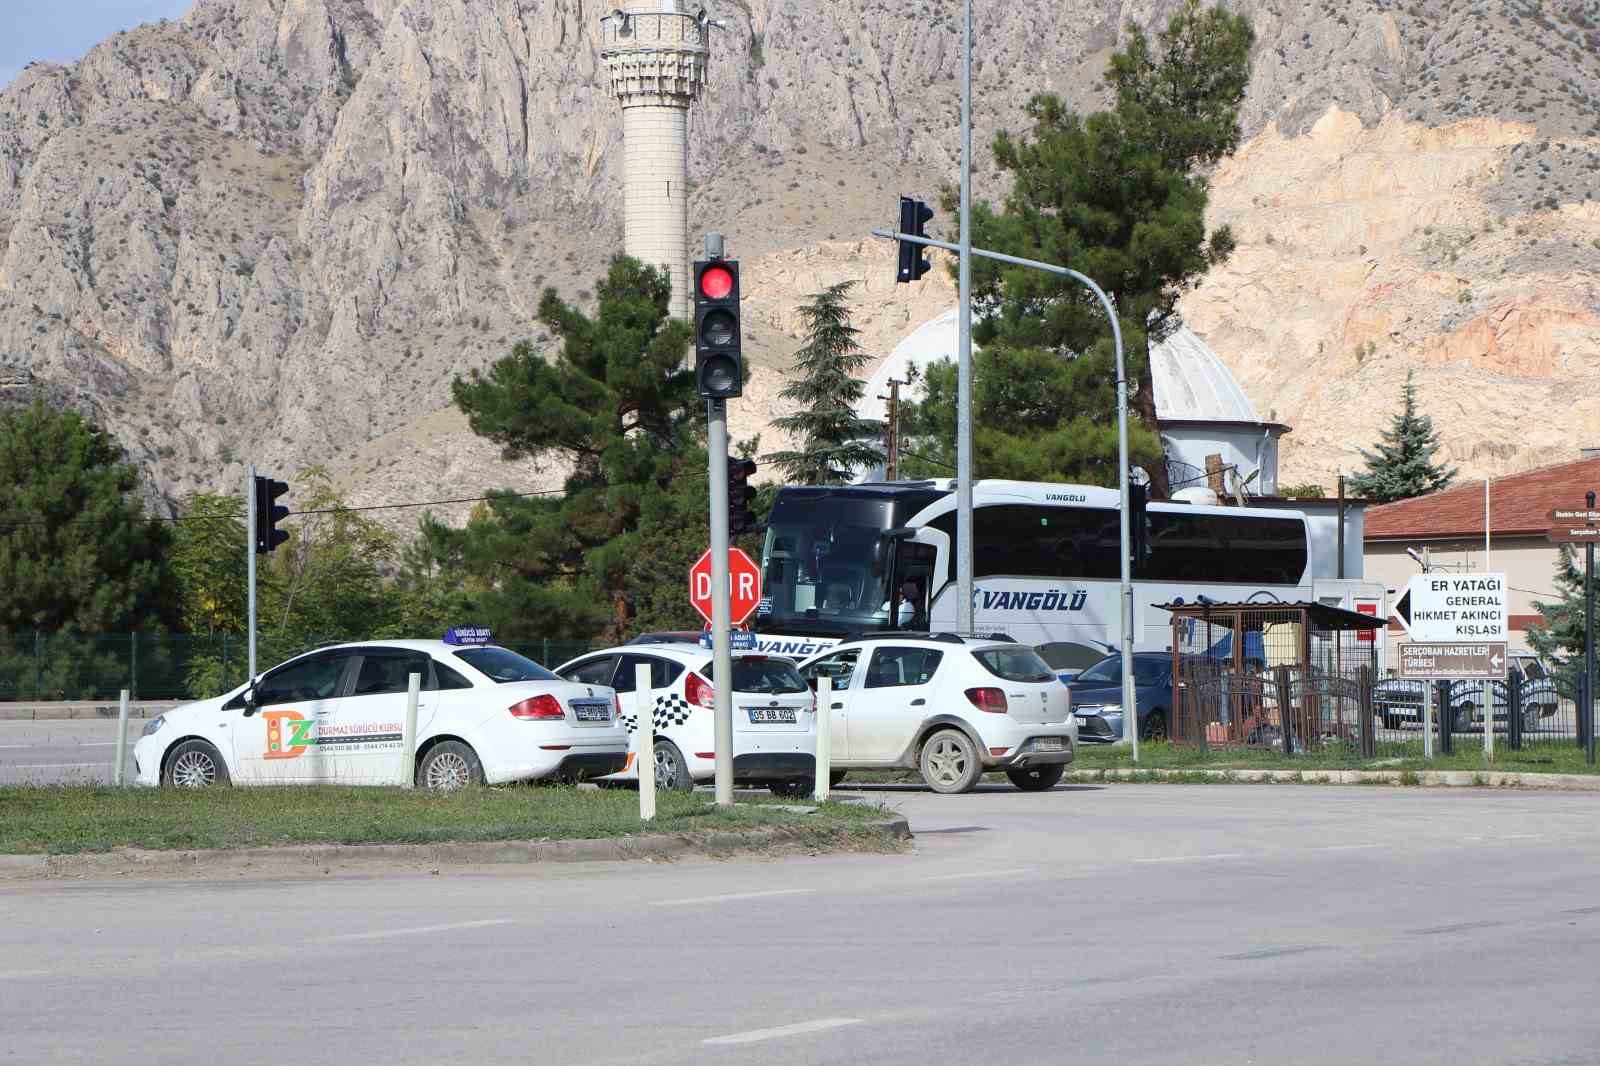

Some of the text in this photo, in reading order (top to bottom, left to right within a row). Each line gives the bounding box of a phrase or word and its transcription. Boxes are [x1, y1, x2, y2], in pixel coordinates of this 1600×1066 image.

[697, 573, 754, 600] DR
[1431, 578, 1501, 591] ER YATAĞI
[982, 589, 1088, 611] VANGÖLÜ
[1446, 596, 1502, 606] GENERAL
[1461, 611, 1501, 620] AKINCI
[1456, 625, 1502, 637] KIŞLASI
[1403, 646, 1442, 657] SERÇOBAN
[753, 710, 765, 720] 05
[766, 710, 777, 720] BB
[379, 721, 402, 733] KURSU
